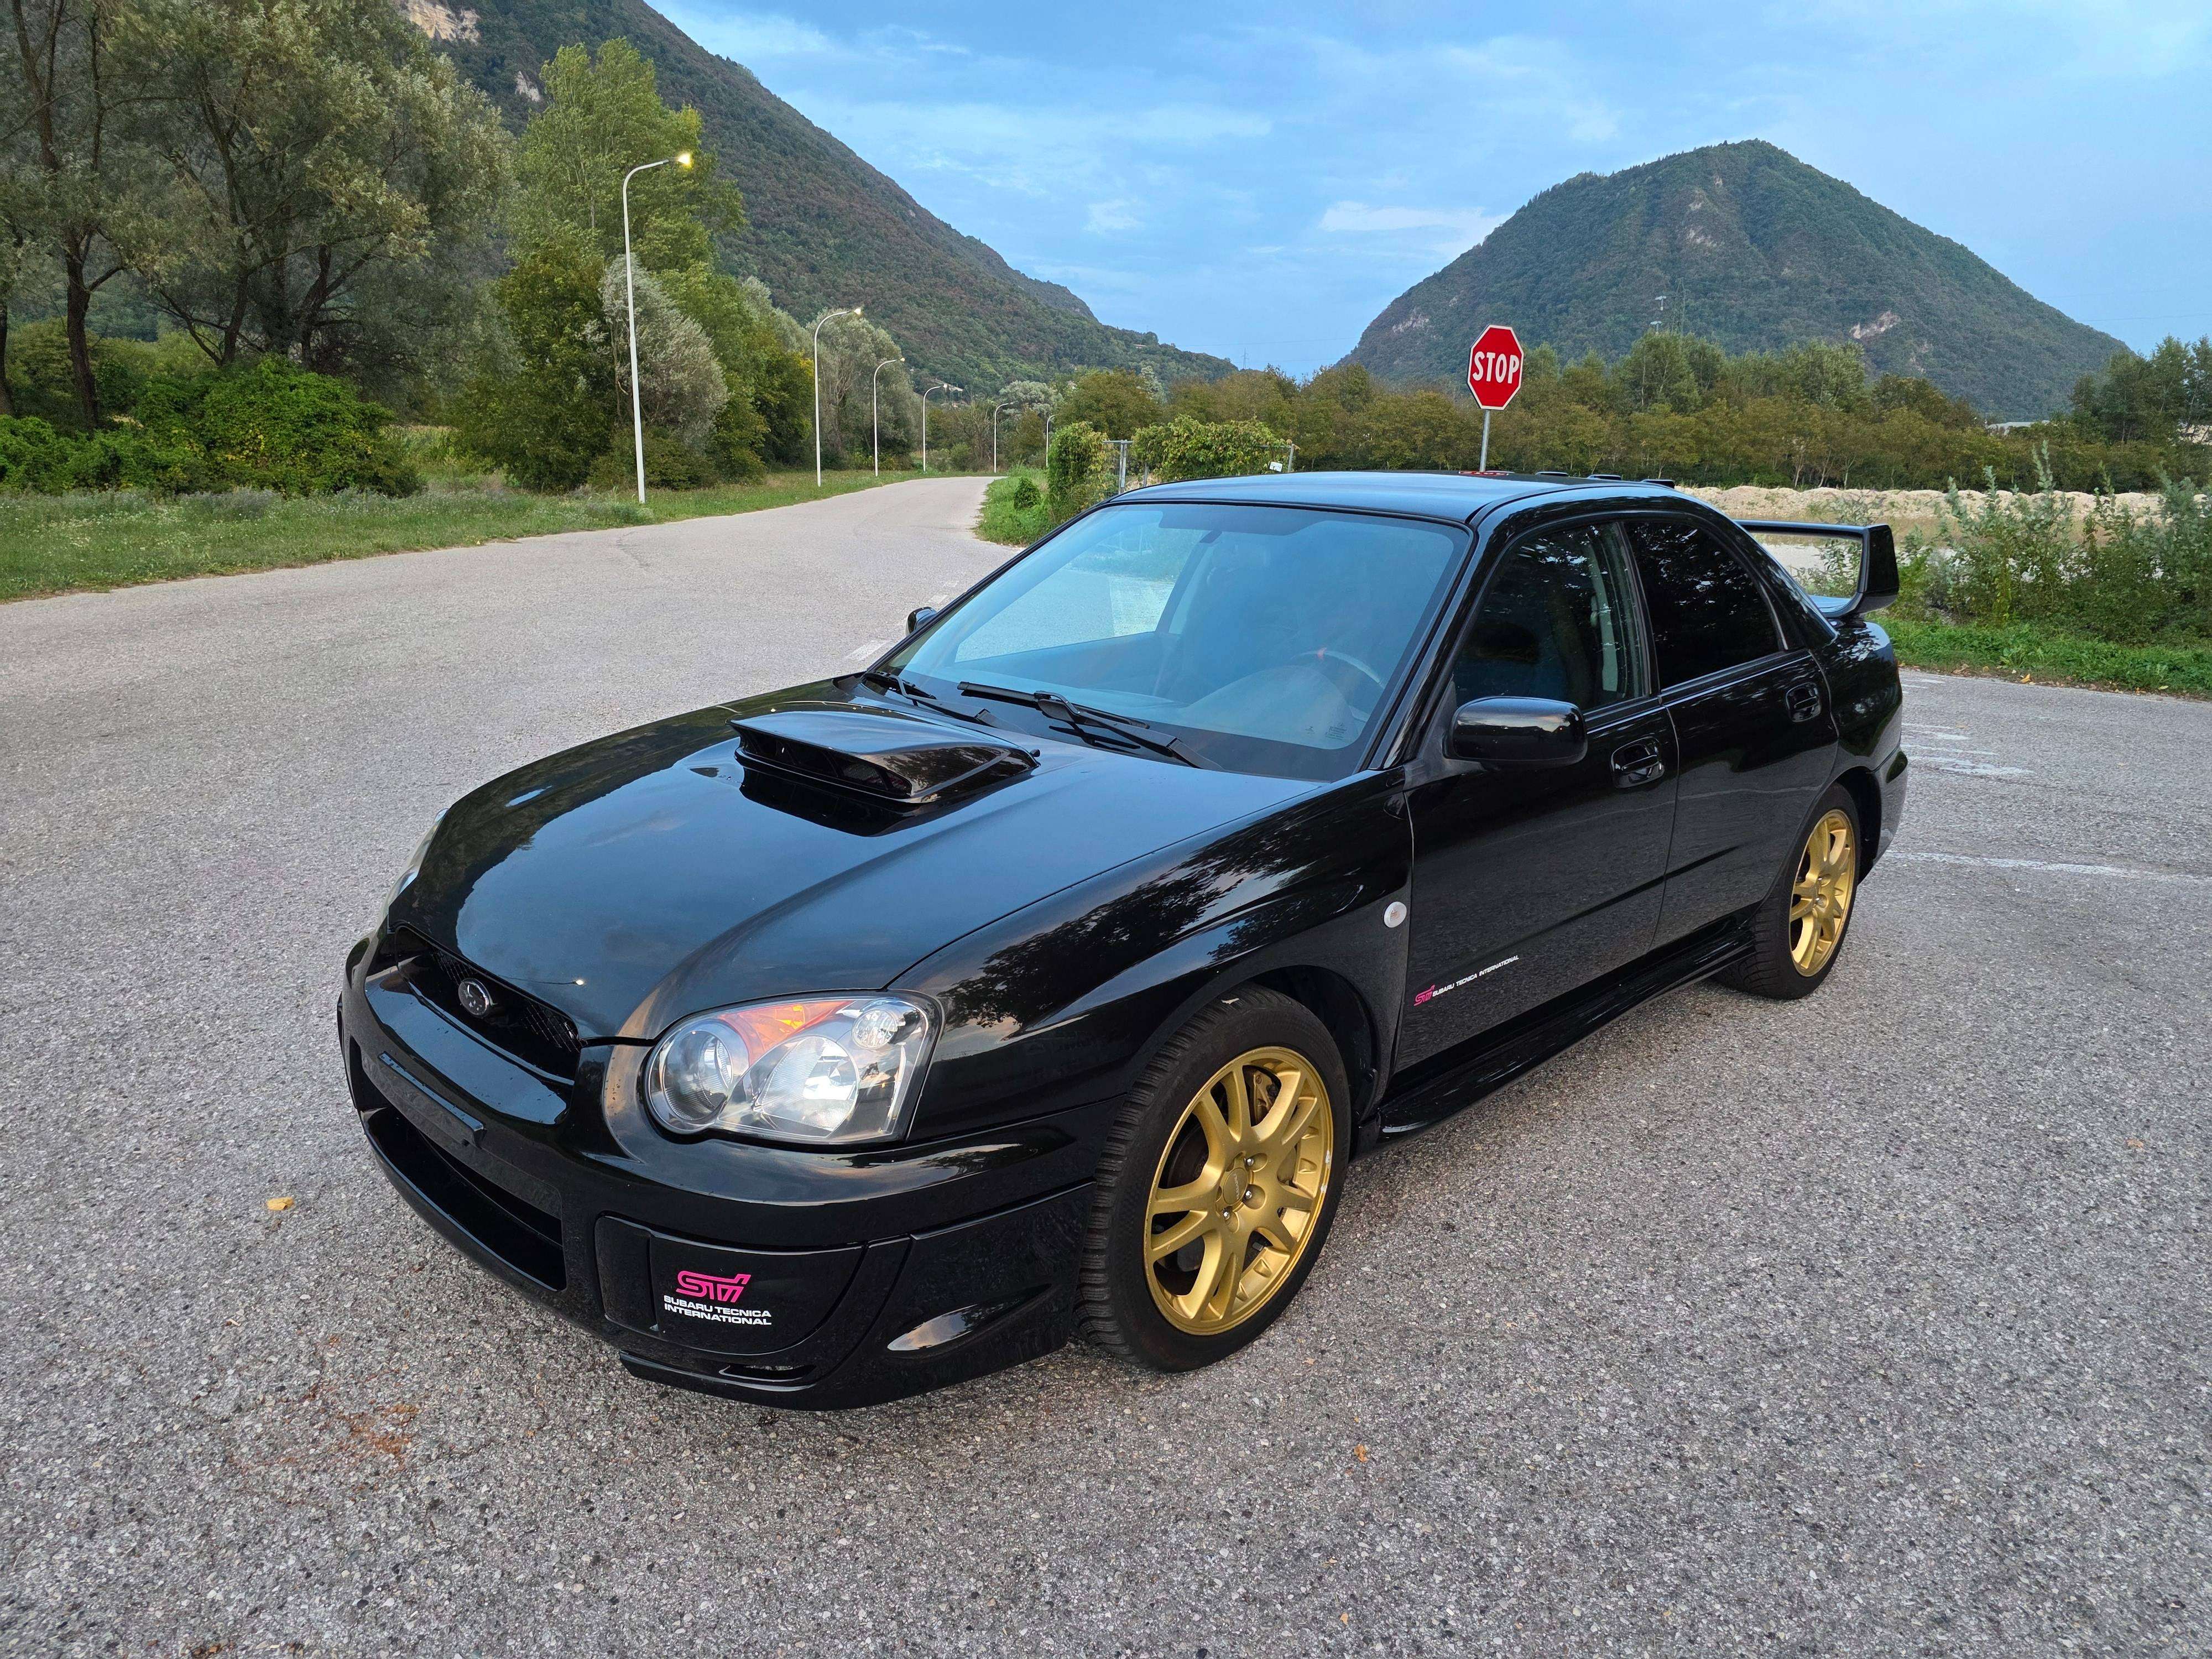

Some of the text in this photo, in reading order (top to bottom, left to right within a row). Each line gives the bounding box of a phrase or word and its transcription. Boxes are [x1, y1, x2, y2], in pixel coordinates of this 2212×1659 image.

[1472, 351, 1520, 384] STOP
[1432, 983, 1455, 997] SUBARU
[1455, 973, 1478, 987] TECNICA
[1479, 954, 1520, 977] INTERNATIONAL
[664, 1295, 772, 1317] SUBARU TECNICA
[664, 1303, 772, 1326] INTERNATIONAL
